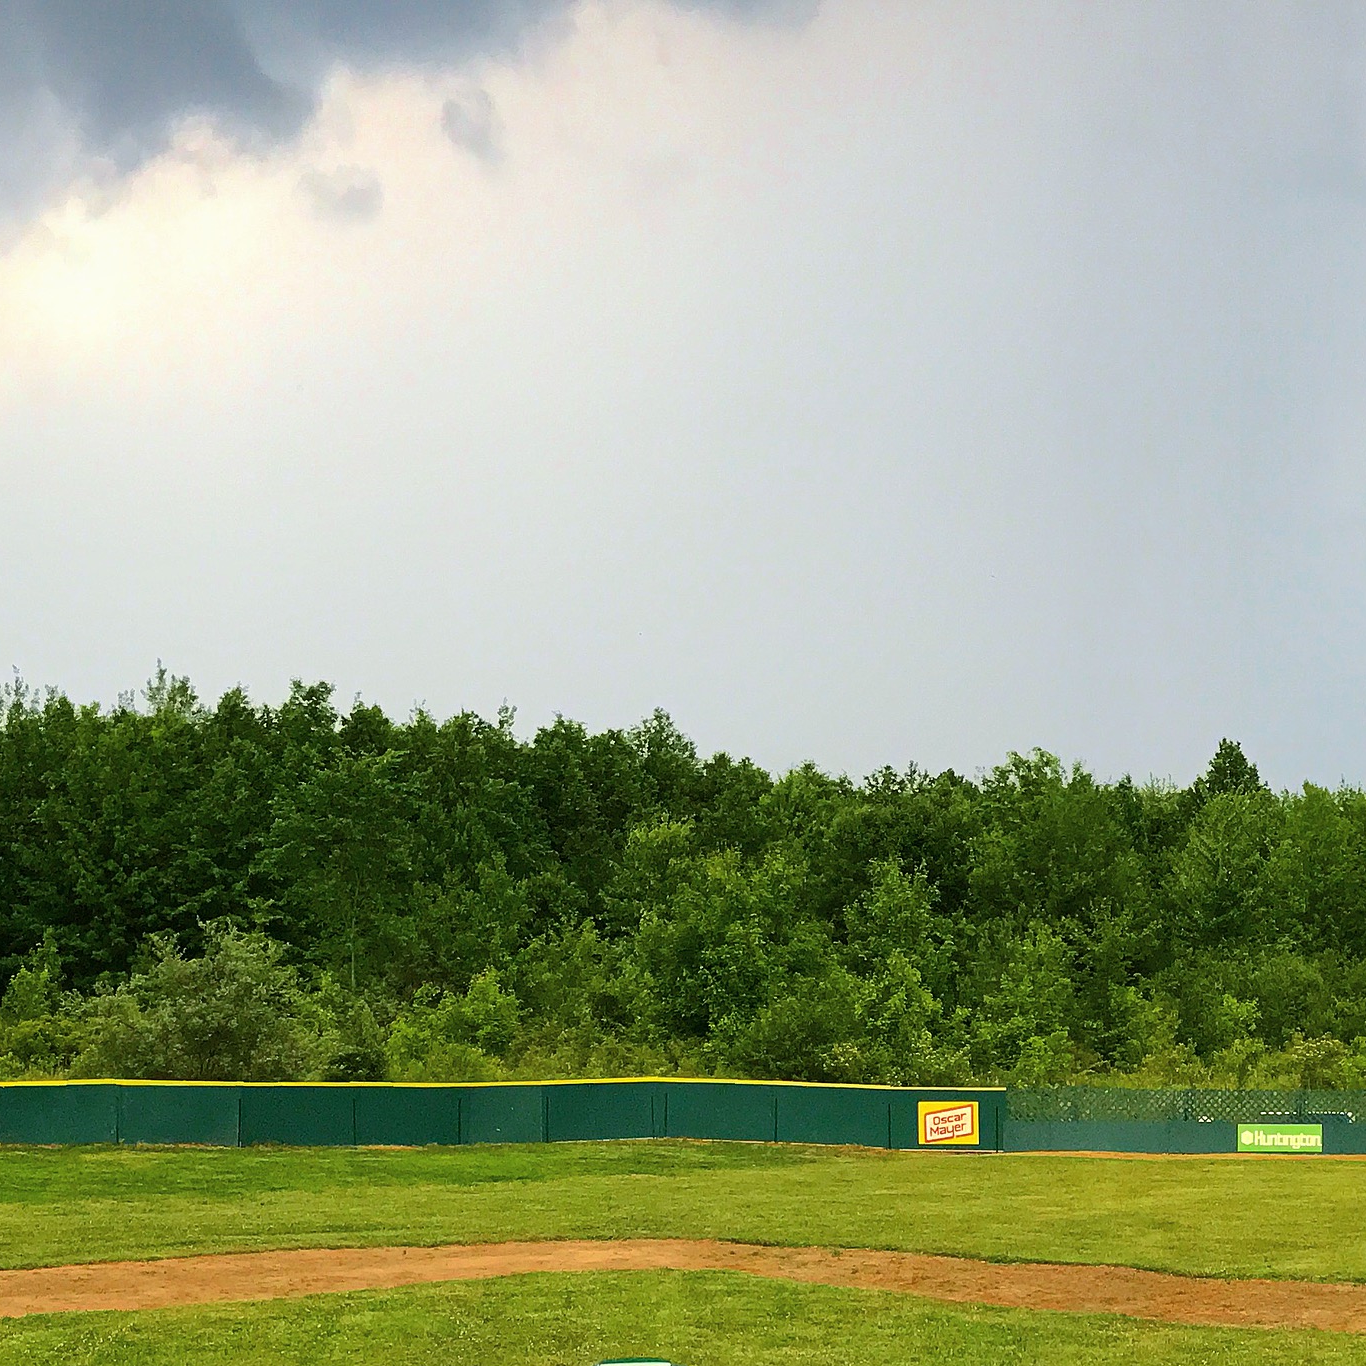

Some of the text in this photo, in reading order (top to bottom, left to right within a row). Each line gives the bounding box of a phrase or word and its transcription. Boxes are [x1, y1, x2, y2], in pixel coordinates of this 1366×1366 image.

[933, 1113, 967, 1126] Oscar
[930, 1123, 967, 1137] Mayer
[1254, 1130, 1322, 1150] Huntington
